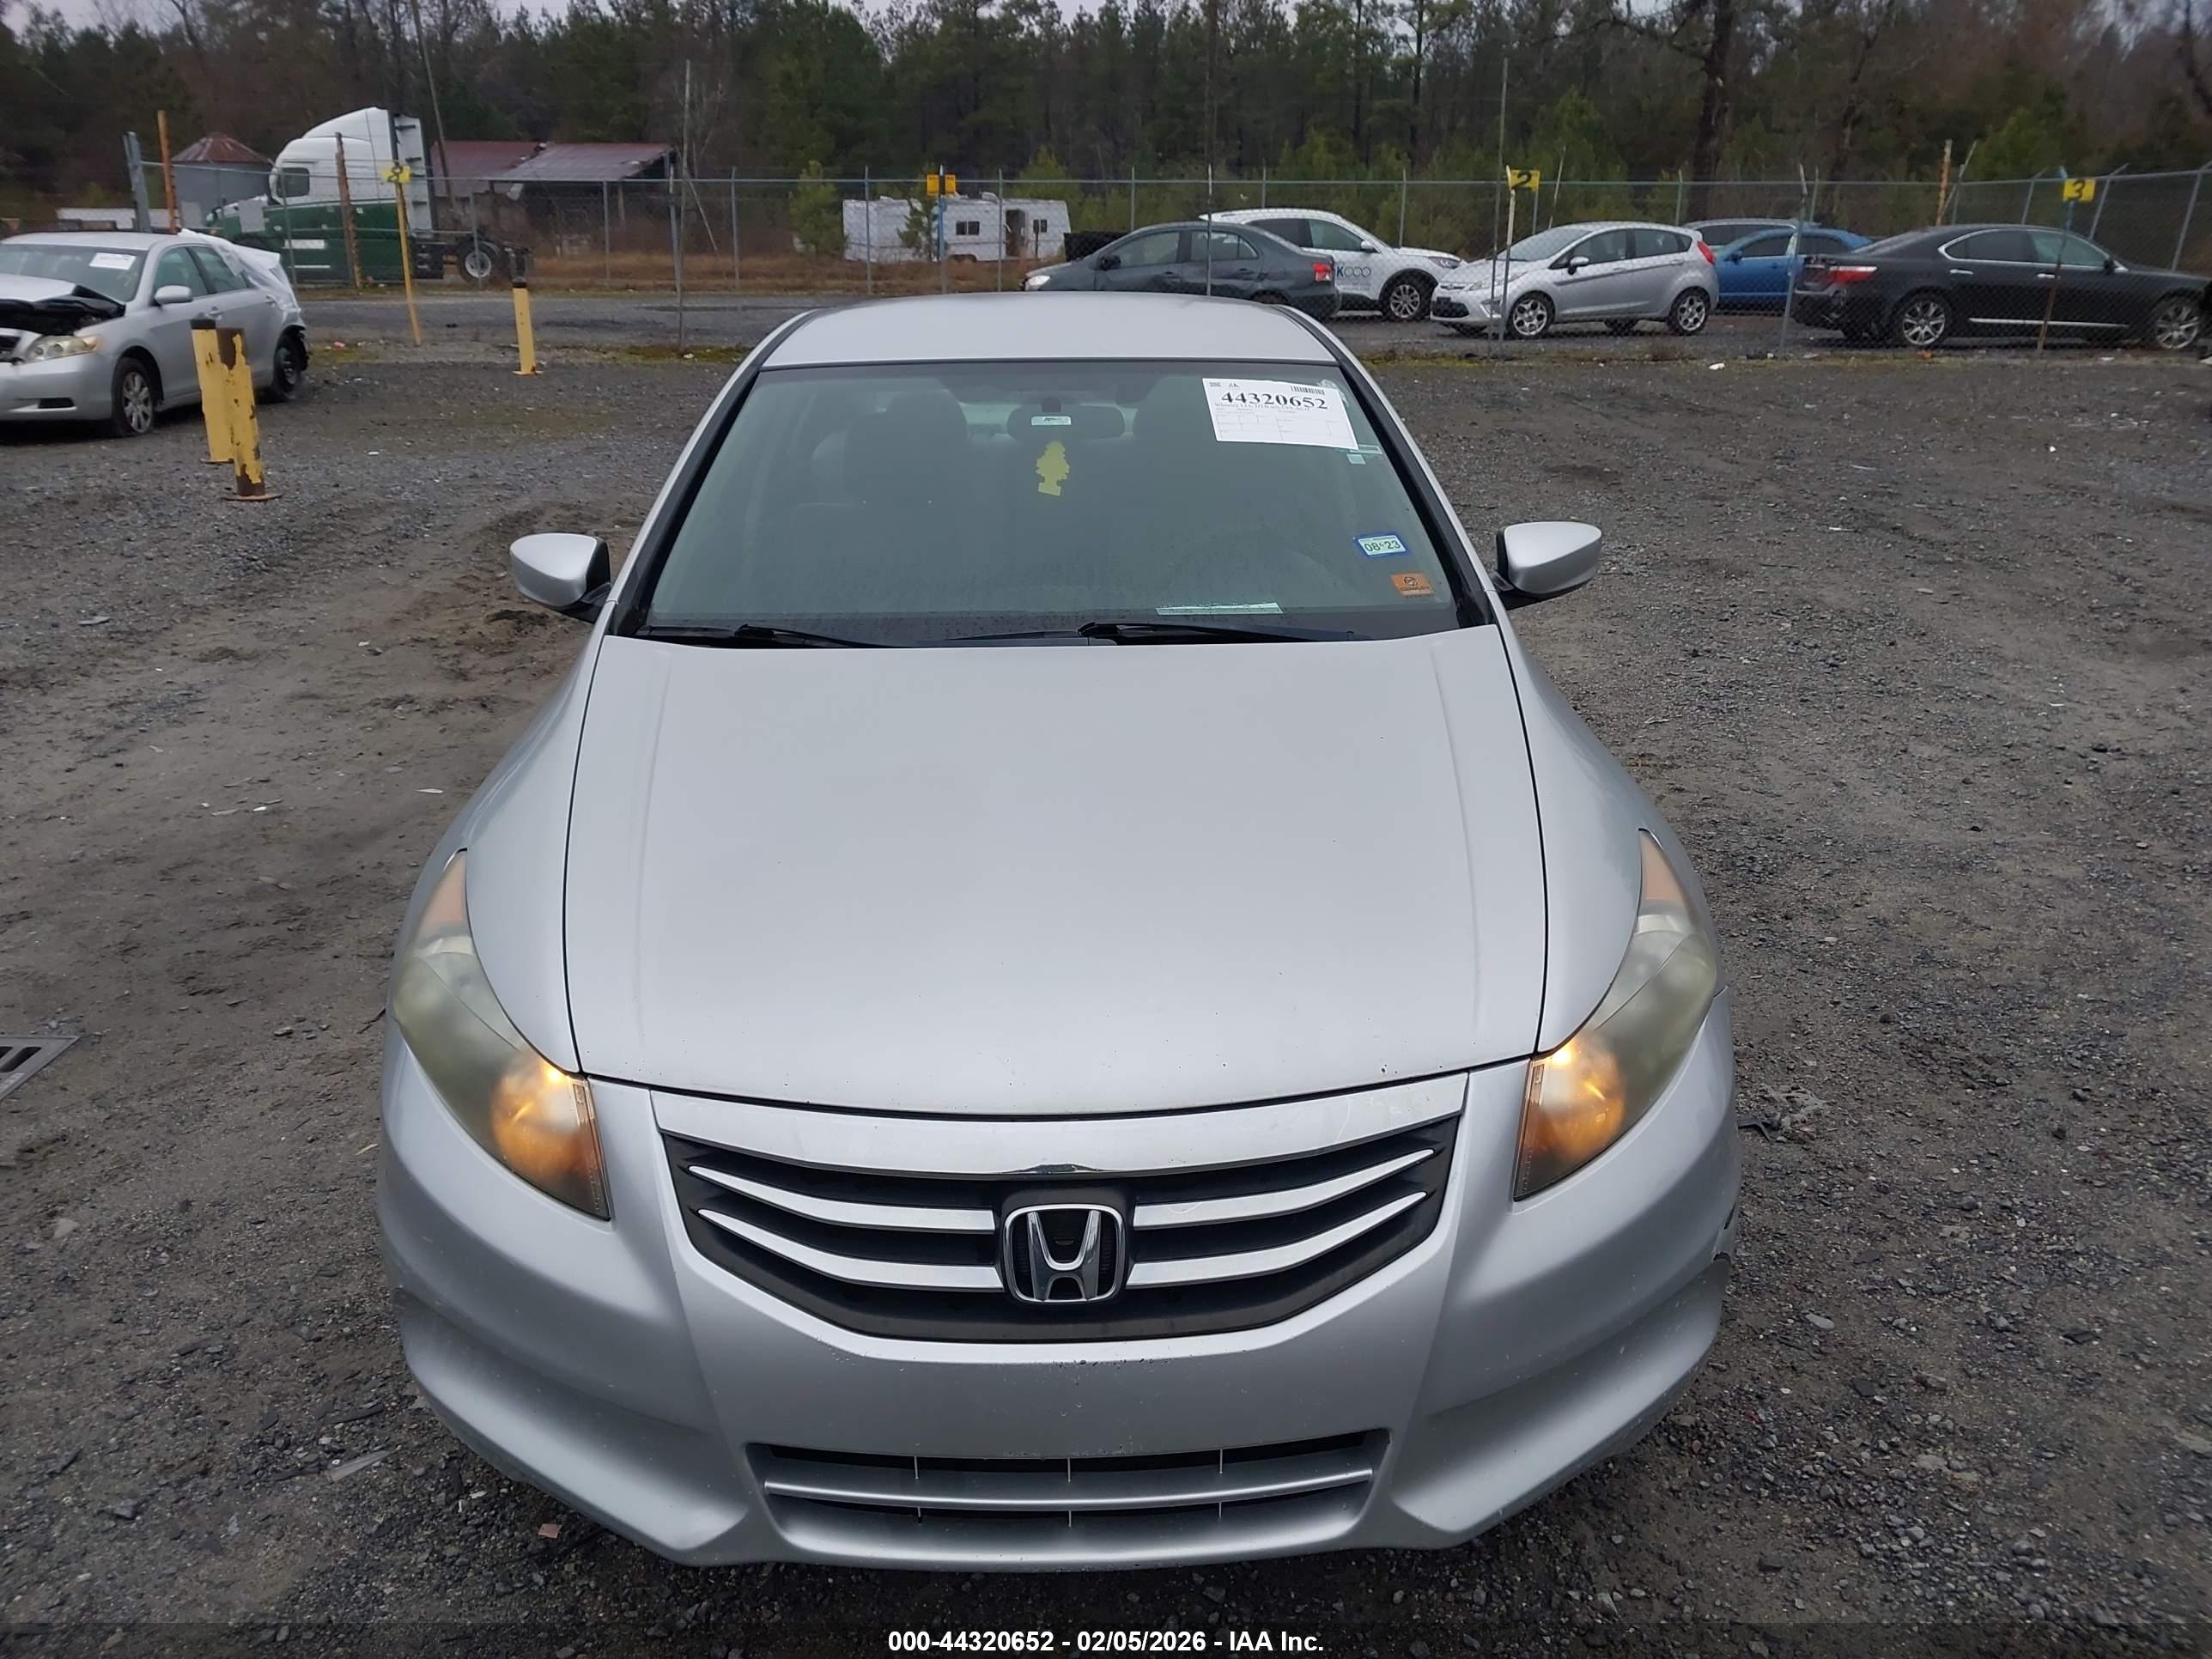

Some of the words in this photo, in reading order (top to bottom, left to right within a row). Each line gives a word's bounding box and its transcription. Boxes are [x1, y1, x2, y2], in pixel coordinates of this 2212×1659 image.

[1511, 170, 1533, 191] 2
[2068, 179, 2086, 199] 3
[1221, 392, 1328, 410] 44320652
[1364, 542, 1381, 552] 08
[1383, 540, 1401, 549] 23
